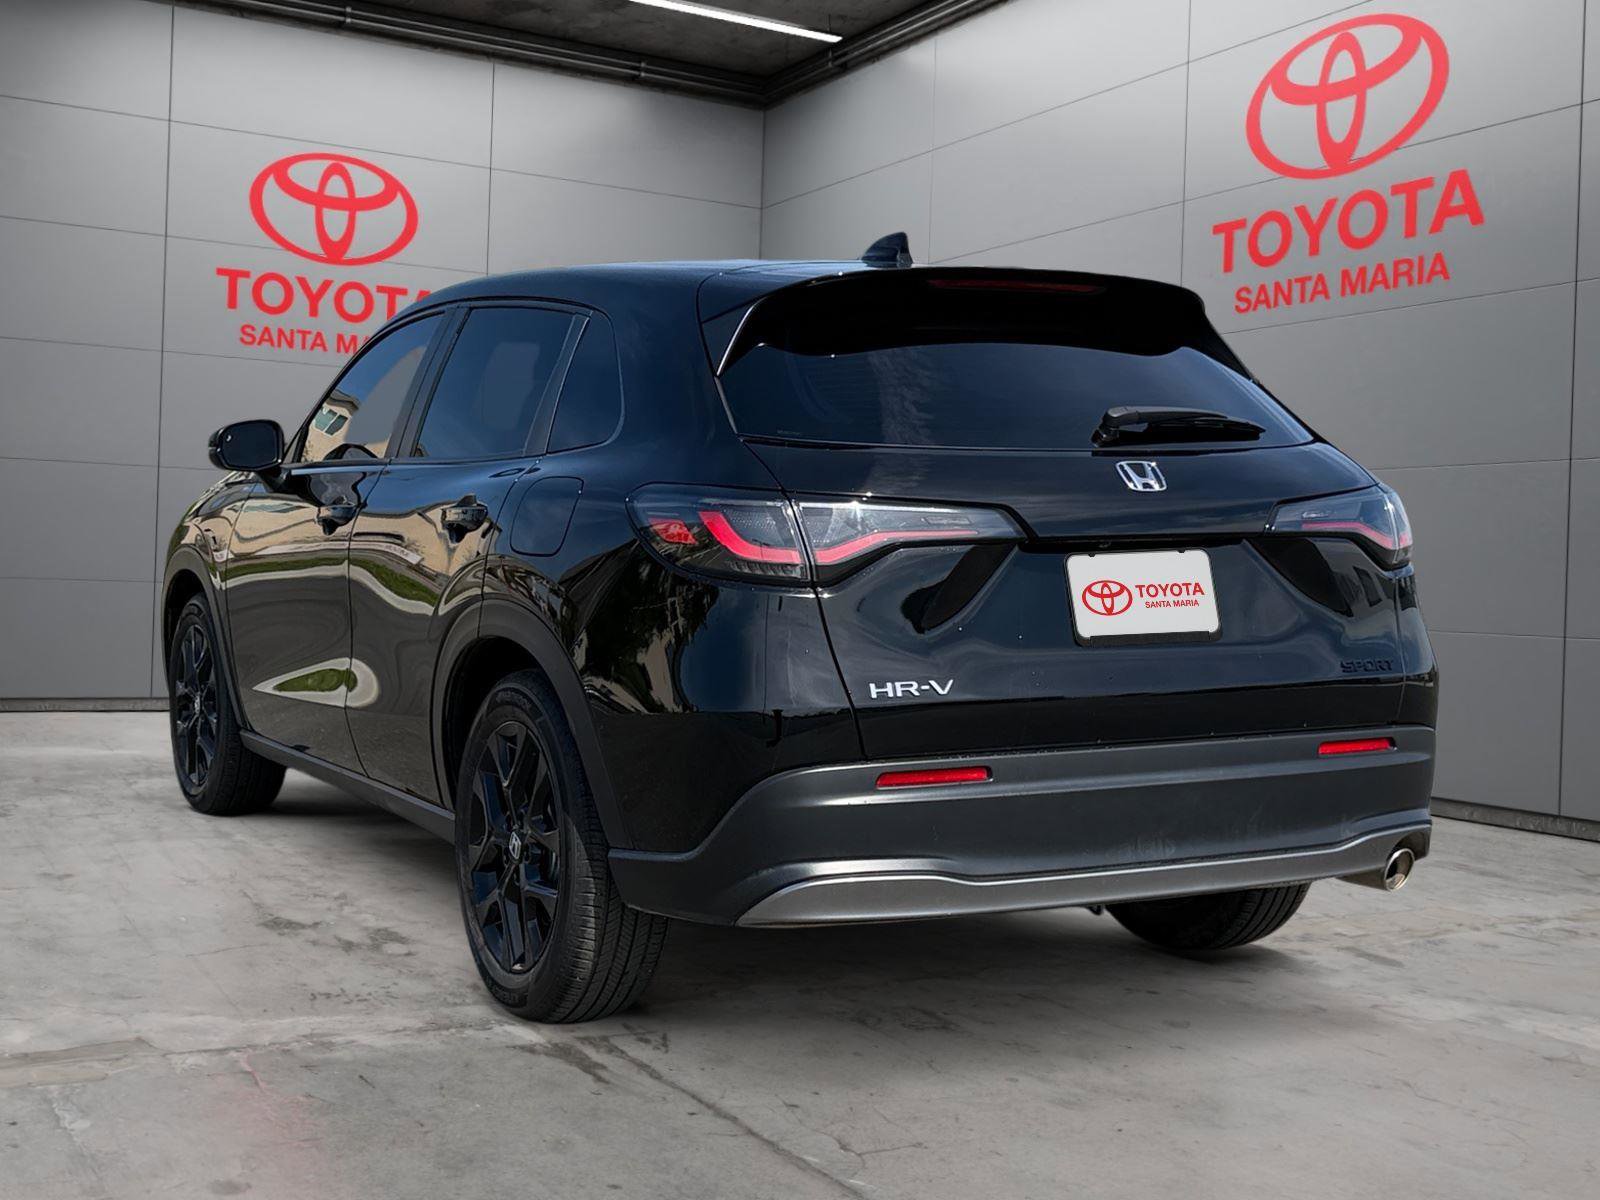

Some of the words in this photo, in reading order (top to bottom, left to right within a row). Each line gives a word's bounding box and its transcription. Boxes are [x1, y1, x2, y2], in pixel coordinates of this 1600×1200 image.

[1211, 168, 1485, 274] TOYOTA
[215, 266, 432, 325] TOYOT
[1234, 272, 1331, 315] SANTA
[1340, 251, 1451, 298] MARIA
[239, 323, 329, 353] SANTA
[1135, 582, 1205, 598] TOYOTA
[1145, 600, 1172, 609] SANTA
[1173, 599, 1200, 608] MARIA
[1341, 660, 1394, 673] SPORT
[868, 679, 954, 699] HR-V
